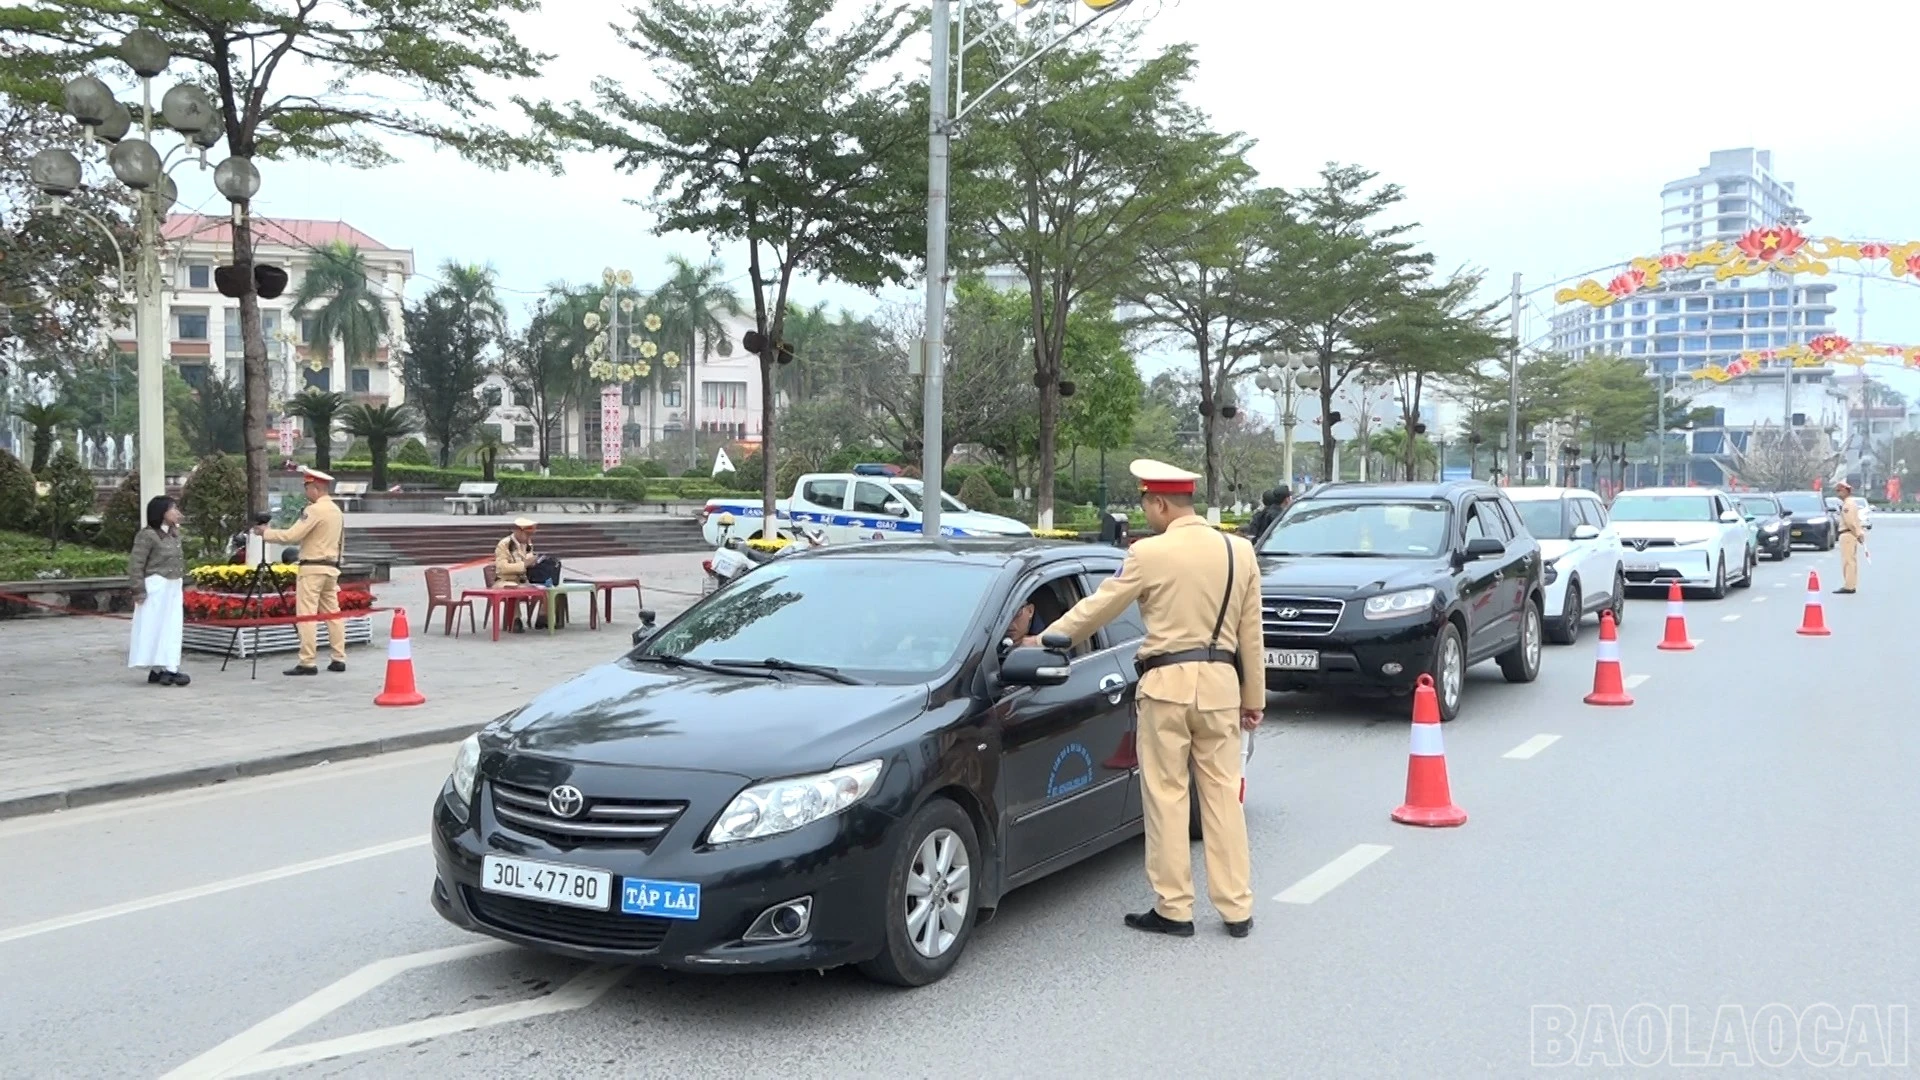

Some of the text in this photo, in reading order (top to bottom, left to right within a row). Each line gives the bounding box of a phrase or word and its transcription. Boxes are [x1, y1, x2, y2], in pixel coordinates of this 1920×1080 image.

[492, 862, 598, 900] 30L-477.80
[626, 884, 696, 910] TẬP LÁI
